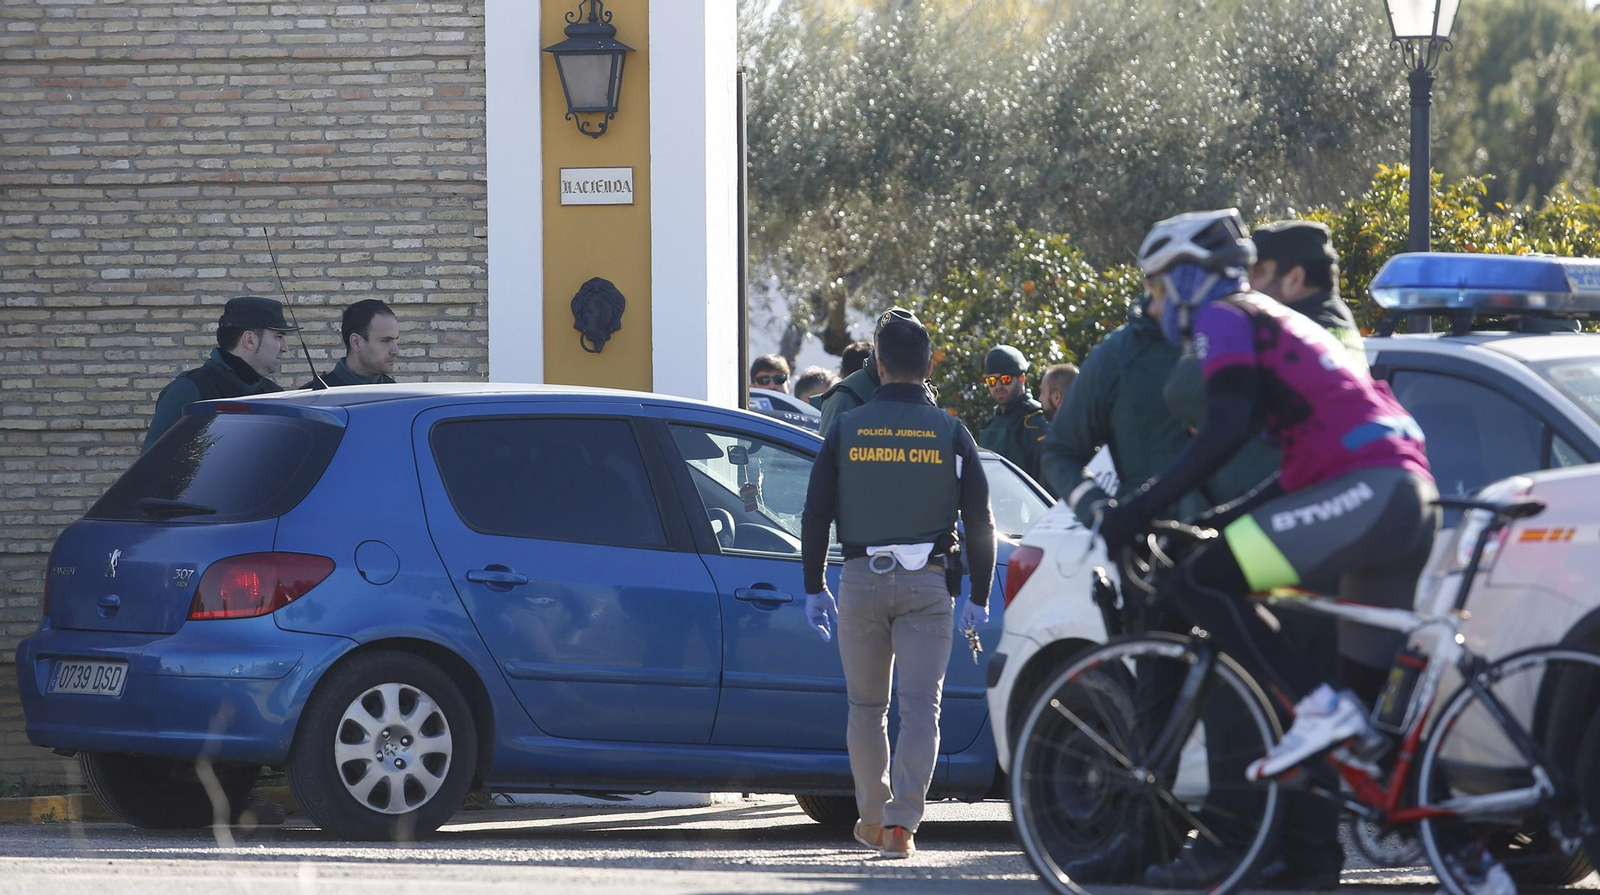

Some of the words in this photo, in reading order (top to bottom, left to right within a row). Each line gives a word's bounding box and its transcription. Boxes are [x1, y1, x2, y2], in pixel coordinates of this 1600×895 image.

[561, 179, 632, 194] HACIENDA
[895, 429, 937, 438] JUDICIAL
[849, 447, 906, 462] GUARDIA
[908, 448, 943, 464] CIVIL
[173, 568, 195, 580] 307
[58, 665, 92, 689] 0739
[92, 665, 123, 691] DSD
